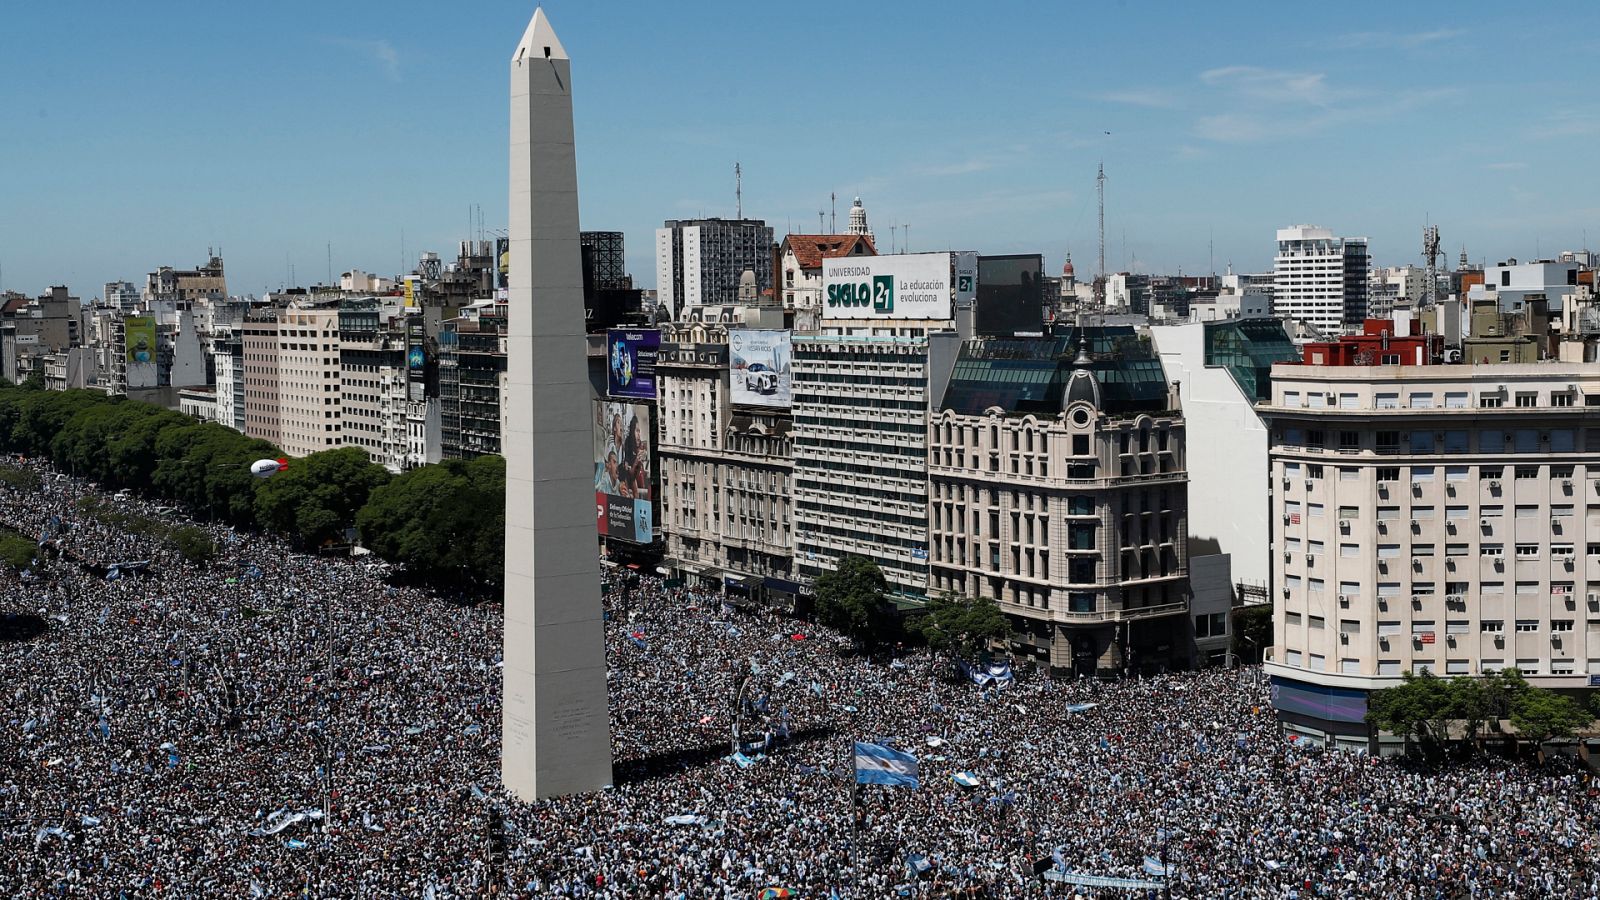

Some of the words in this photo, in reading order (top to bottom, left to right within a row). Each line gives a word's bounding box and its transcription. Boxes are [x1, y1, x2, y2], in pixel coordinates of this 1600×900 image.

[828, 266, 870, 277] UNIVERSIDAD
[900, 280, 908, 290] La
[910, 280, 944, 290] educación
[960, 278, 970, 291] 21
[828, 282, 870, 308] SIGLO
[875, 282, 890, 309] 21
[900, 292, 938, 302] evoluciona
